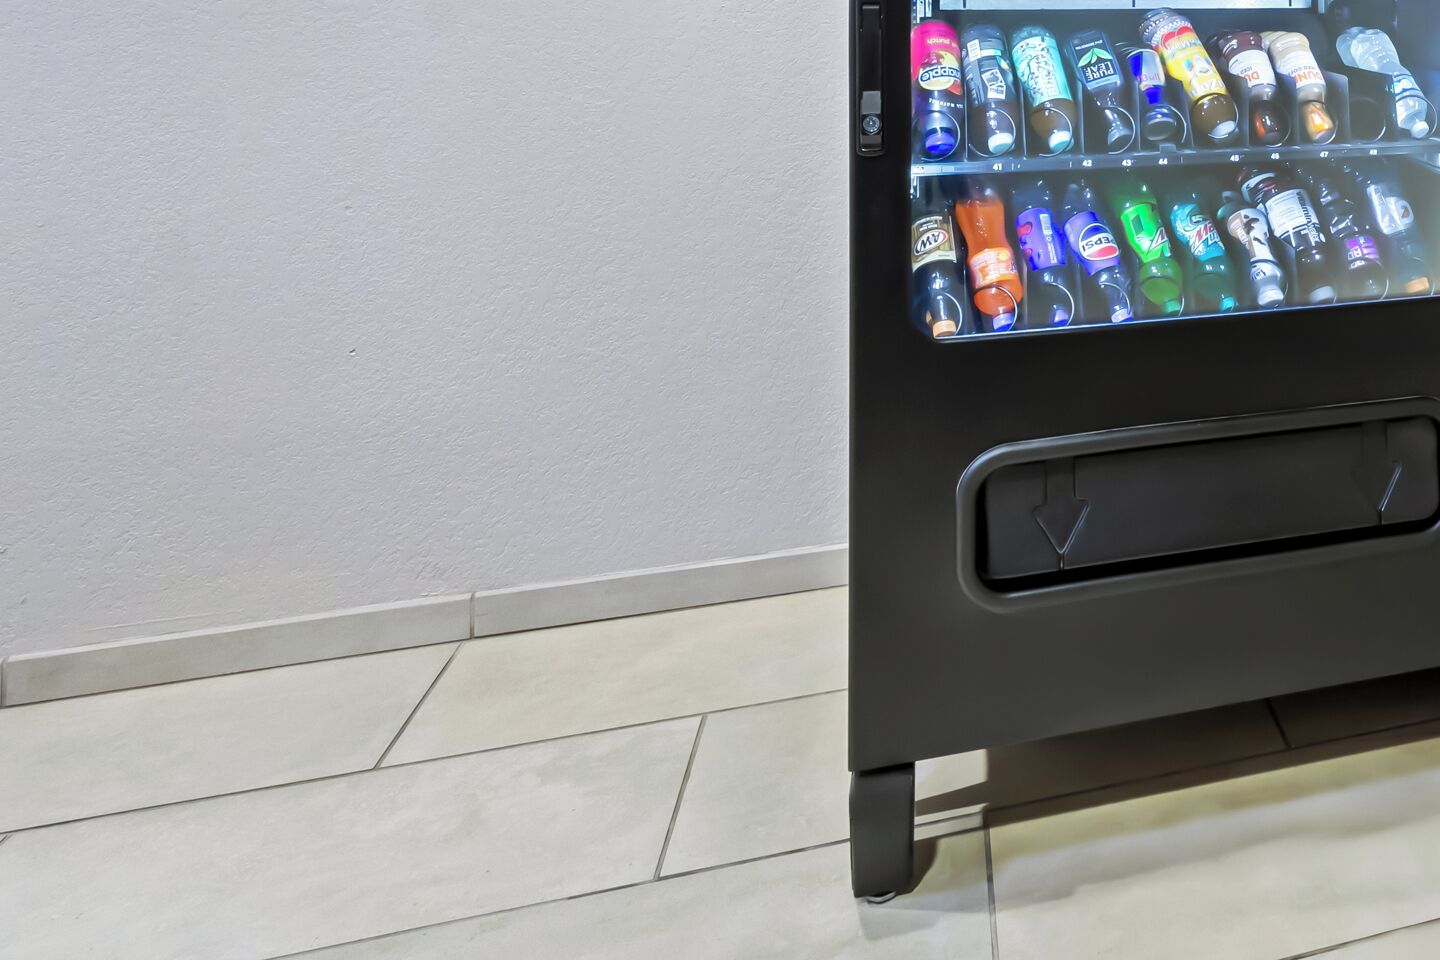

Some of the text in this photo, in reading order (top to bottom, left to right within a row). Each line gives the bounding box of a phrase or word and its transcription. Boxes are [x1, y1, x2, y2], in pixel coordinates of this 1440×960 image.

[1085, 61, 1112, 76] LEAF
[919, 68, 961, 83] napple
[1087, 68, 1114, 82] PURE
[1230, 154, 1240, 162] 45
[1270, 152, 1280, 160] 46
[1082, 159, 1093, 167] 42
[1121, 159, 1132, 167] 43
[1158, 158, 1168, 166] 44
[992, 163, 1003, 171] 41
[1081, 236, 1111, 252] PEPSI
